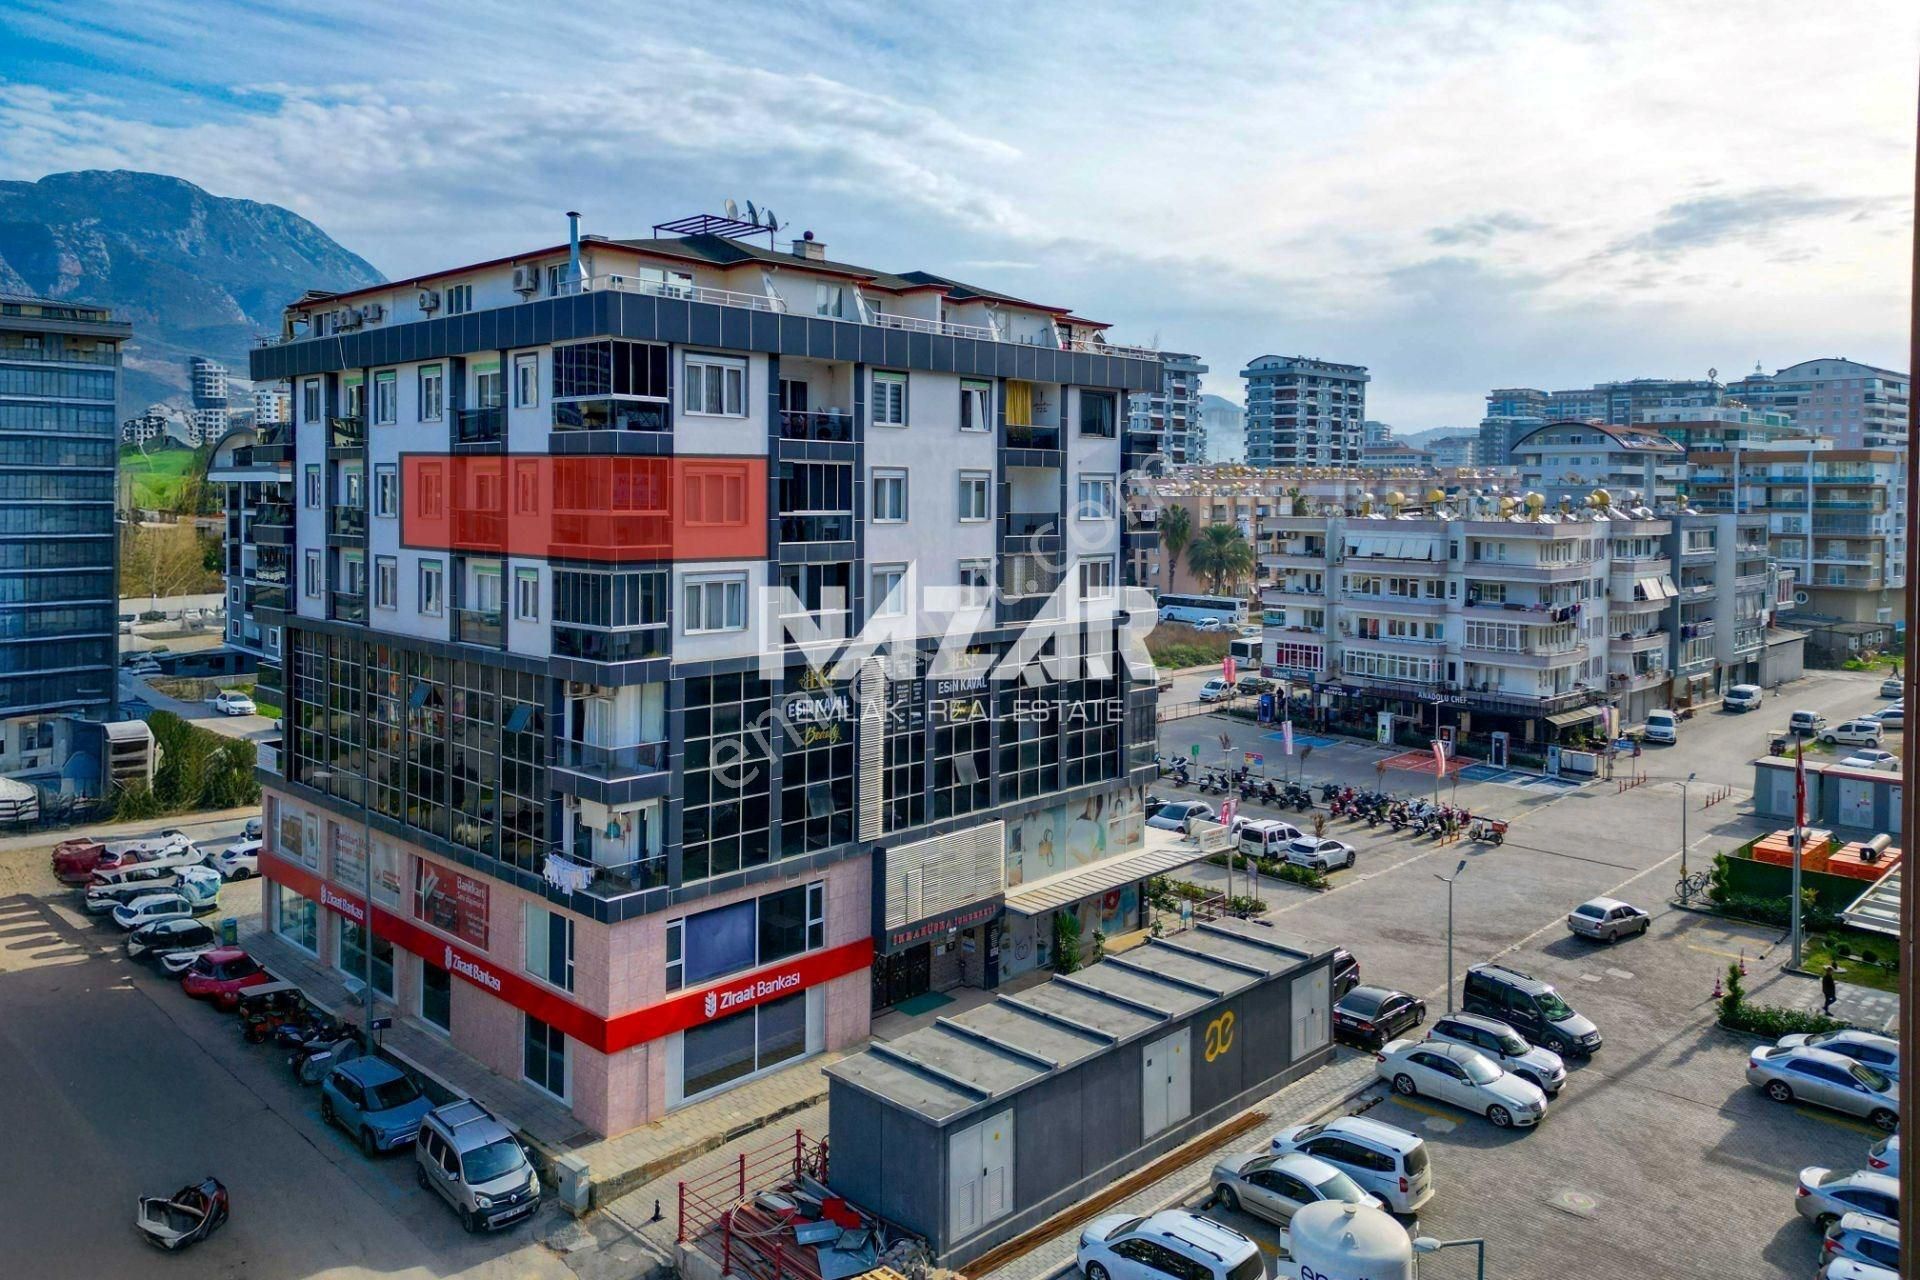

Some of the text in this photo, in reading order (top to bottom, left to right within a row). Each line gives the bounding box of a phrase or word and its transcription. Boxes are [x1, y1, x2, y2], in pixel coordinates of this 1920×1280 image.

[960, 676, 987, 691] KAVAL
[1417, 690, 1468, 704] ANADOLU CHEF
[326, 890, 343, 910] Ziraat
[453, 954, 501, 992] Ziraat Bankası
[719, 972, 800, 1010] Ziraat Bankası
